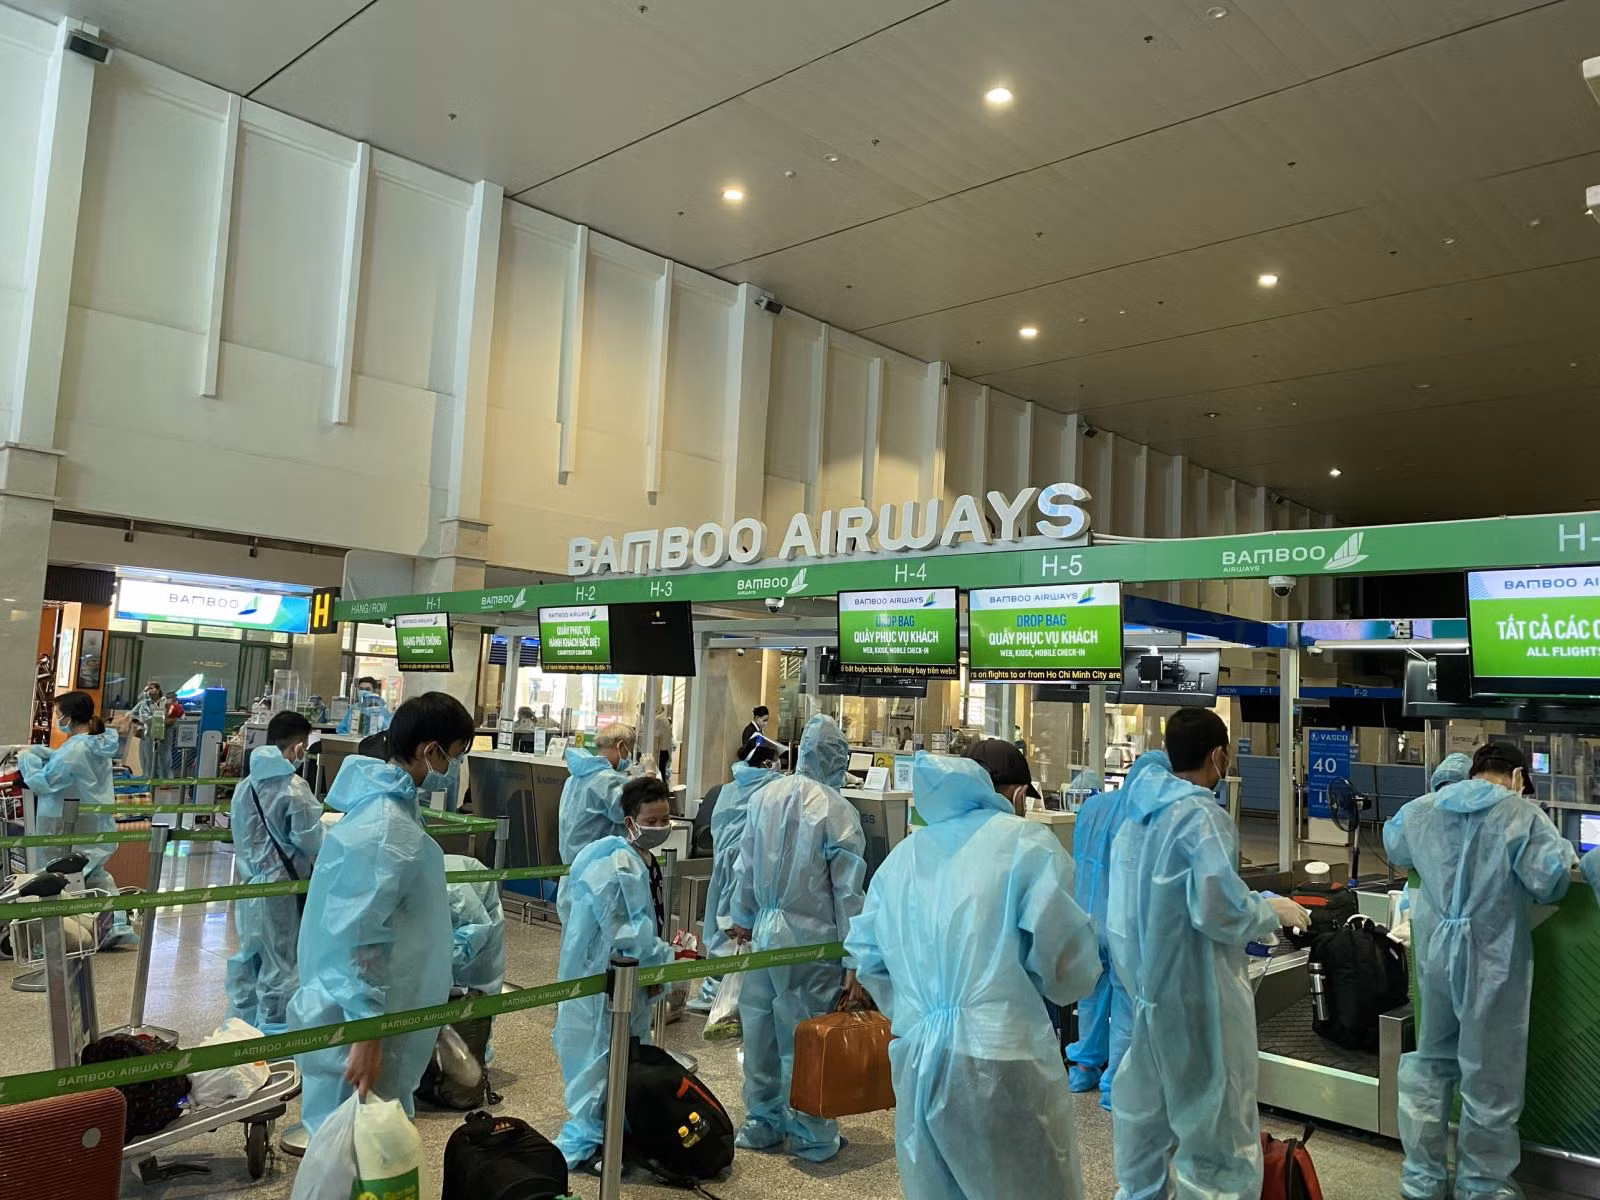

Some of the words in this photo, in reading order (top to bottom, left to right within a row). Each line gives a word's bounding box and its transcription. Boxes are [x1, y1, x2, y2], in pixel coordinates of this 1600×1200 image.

[567, 517, 766, 577] BAMBOO
[778, 481, 1092, 560] AIRWAYS
[1222, 545, 1326, 565] BAMBOO
[895, 563, 927, 583] H-4
[1042, 554, 1083, 577] H-5
[1223, 565, 1260, 573] AIRWAYS
[650, 580, 673, 598] H-3
[737, 577, 789, 590] BAMBOO
[1504, 577, 1577, 590] BAMBOO
[481, 594, 514, 605] BAMBOO
[575, 585, 596, 601] H-2
[889, 596, 924, 604] AIRWAYS
[989, 595, 1031, 604] BAMBOO
[1034, 592, 1078, 601] AIRWAYS
[169, 593, 239, 609] BAMBOO
[426, 596, 441, 611] H-1
[313, 593, 330, 628] H
[898, 615, 915, 627] BAG
[1017, 614, 1044, 627] DROP
[1045, 613, 1067, 627] BAG
[1496, 613, 1526, 640] TẤT
[1529, 613, 1552, 640] CẢ
[1554, 614, 1590, 640] CÁC
[875, 630, 897, 646] PHỤC
[898, 630, 909, 646] VỤ
[910, 627, 939, 643] KHÁCH
[1016, 631, 1044, 648] PHỤC
[1045, 631, 1060, 648] VỤ
[1061, 626, 1098, 644] KHÁCH
[1000, 649, 1014, 658] WEB,
[1015, 649, 1034, 658] KIOSK,
[1034, 649, 1056, 657] MOBILE
[1057, 648, 1086, 657] CHECK-IN
[1526, 646, 1550, 657] ALL
[916, 666, 927, 676] bay
[988, 670, 1009, 680] flights
[1028, 670, 1045, 678] from
[1046, 670, 1057, 678] Ho
[1058, 670, 1071, 678] Chi
[1072, 670, 1091, 678] Minh
[1092, 670, 1107, 681] City
[1260, 687, 1272, 695] F-1
[1354, 689, 1368, 697] F-2
[1320, 733, 1348, 741] VASCO
[1312, 757, 1337, 773] 40
[502, 994, 536, 1007] BAMBOO
[537, 987, 570, 1000] AIRWAYS
[380, 1014, 422, 1031] BAMBOO
[423, 1008, 461, 1023] AIRWAYS
[234, 1040, 282, 1058] BAMBOO
[284, 1033, 330, 1049] AIRWAYS
[57, 1070, 116, 1087] BAMBOO
[119, 1060, 174, 1077] AIRWAYS
